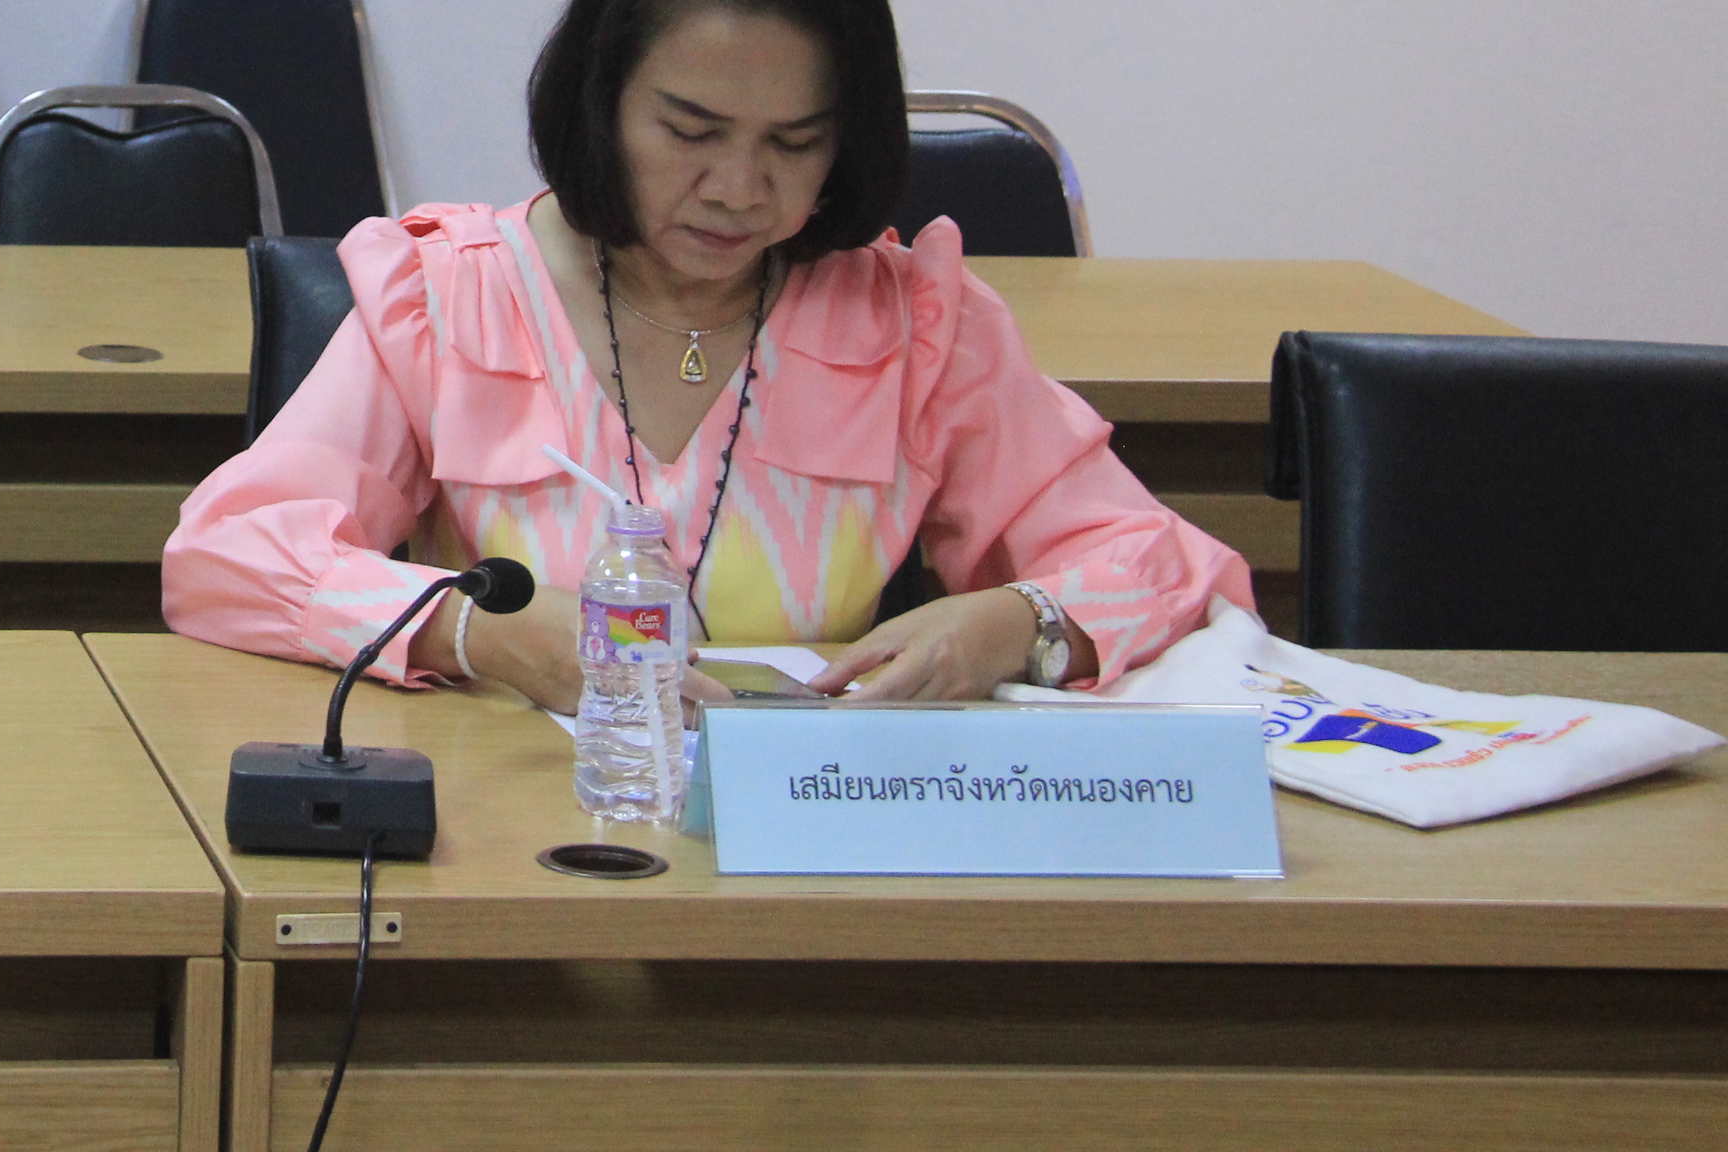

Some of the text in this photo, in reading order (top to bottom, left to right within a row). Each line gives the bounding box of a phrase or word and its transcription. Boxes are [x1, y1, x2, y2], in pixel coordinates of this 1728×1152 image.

[639, 611, 660, 622] Care
[635, 619, 661, 630] Bears
[789, 762, 1195, 804] เสมียนตราจังหวัดหนองคาย
